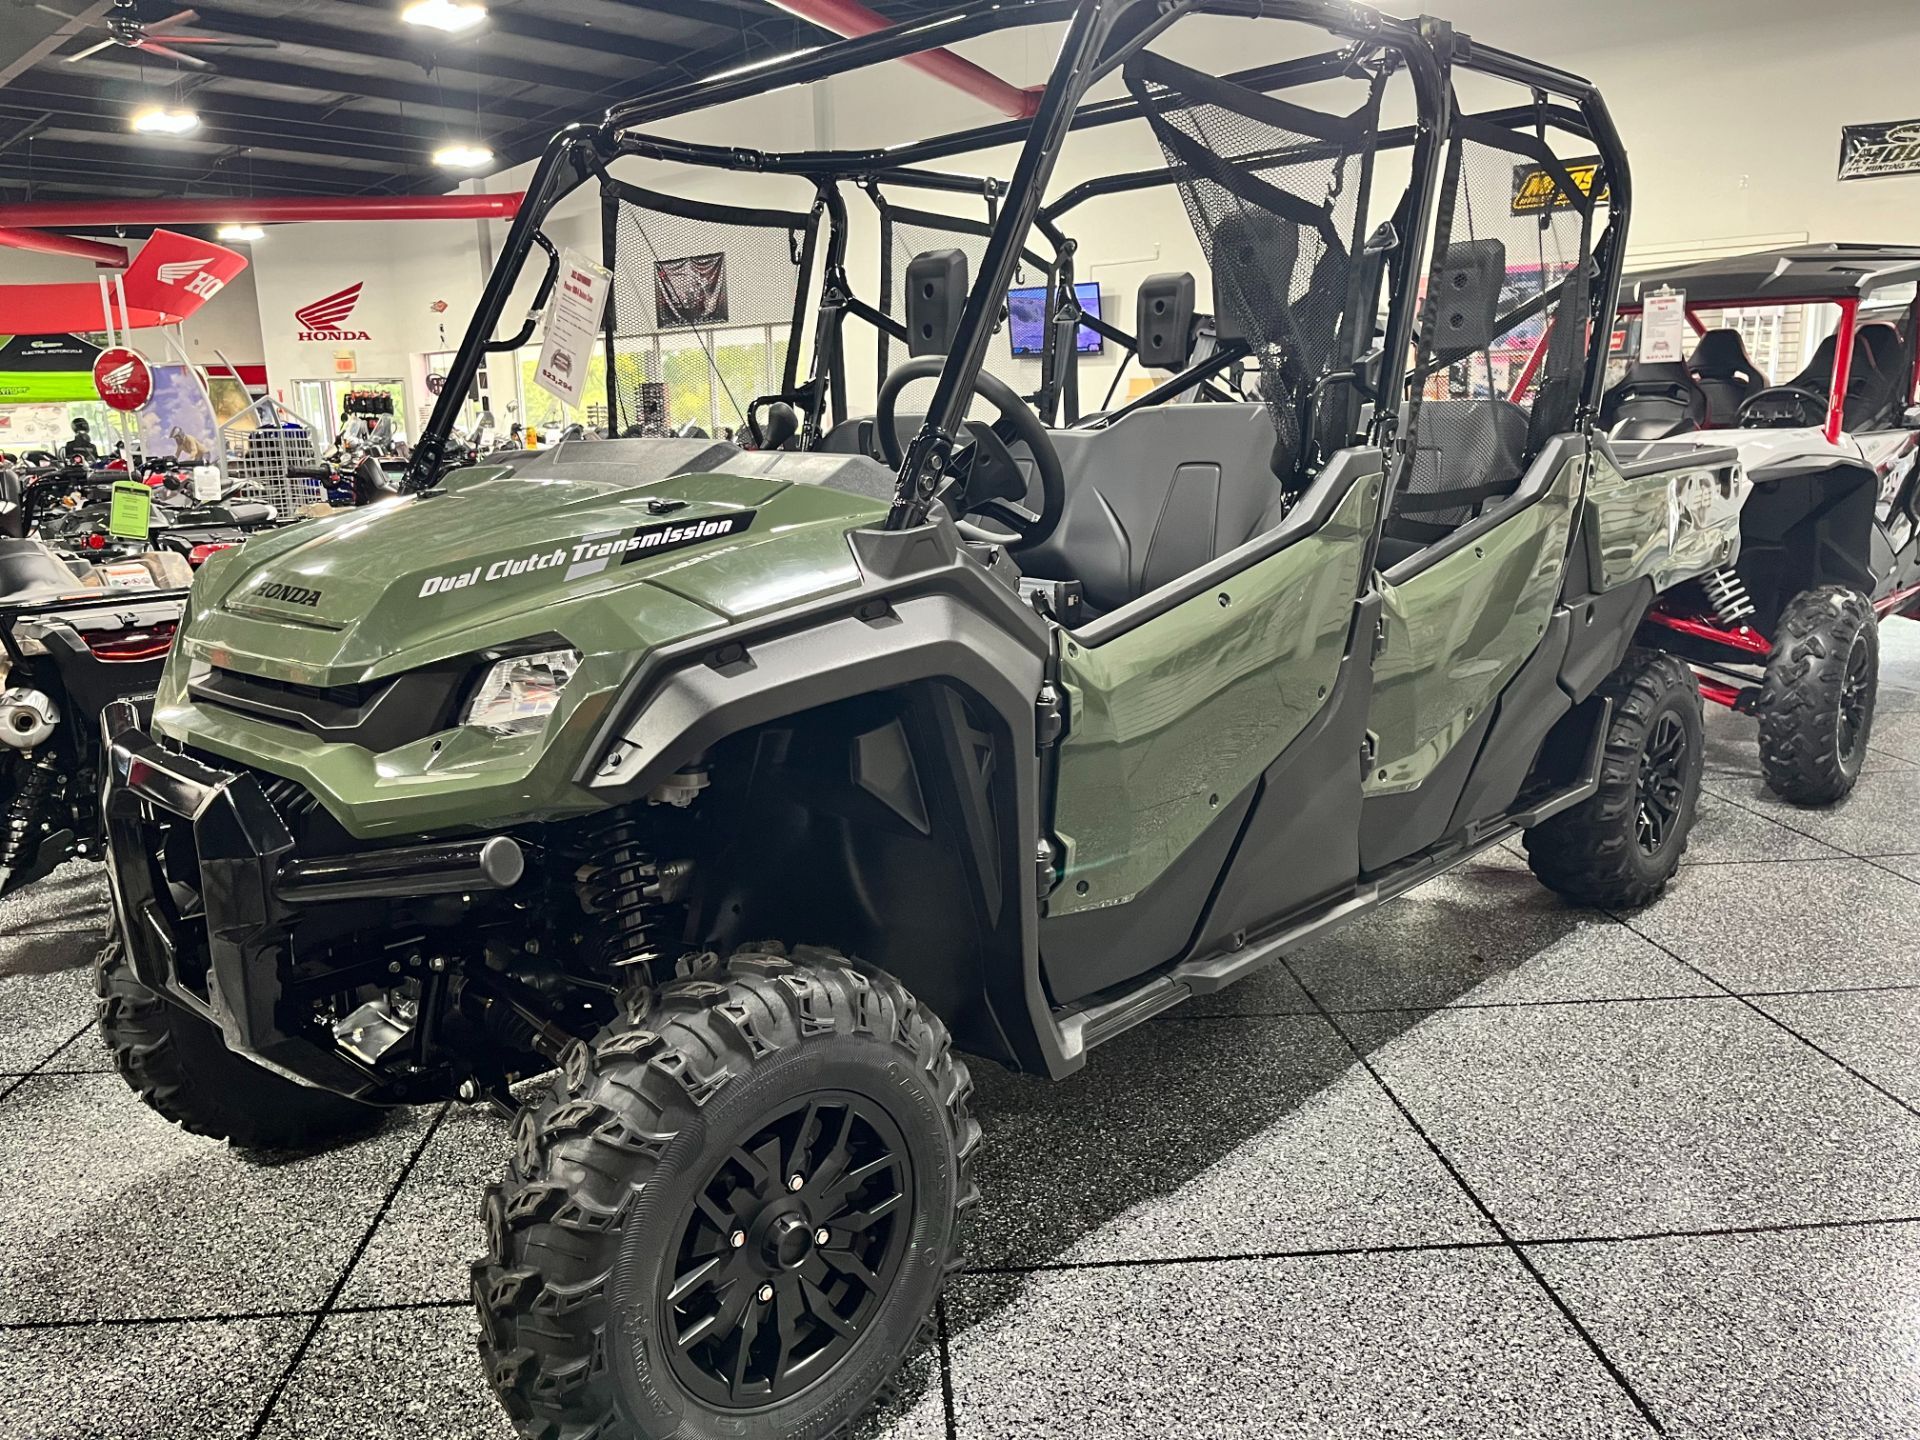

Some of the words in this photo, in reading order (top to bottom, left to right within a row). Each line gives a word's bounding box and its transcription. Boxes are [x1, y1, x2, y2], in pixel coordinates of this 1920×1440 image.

[298, 331, 372, 341] HONDA
[418, 566, 482, 598] Dual
[485, 548, 567, 582] Clutch
[571, 518, 734, 563] Transmission
[251, 581, 322, 607] HONDA
[117, 694, 157, 702] RUBIC
